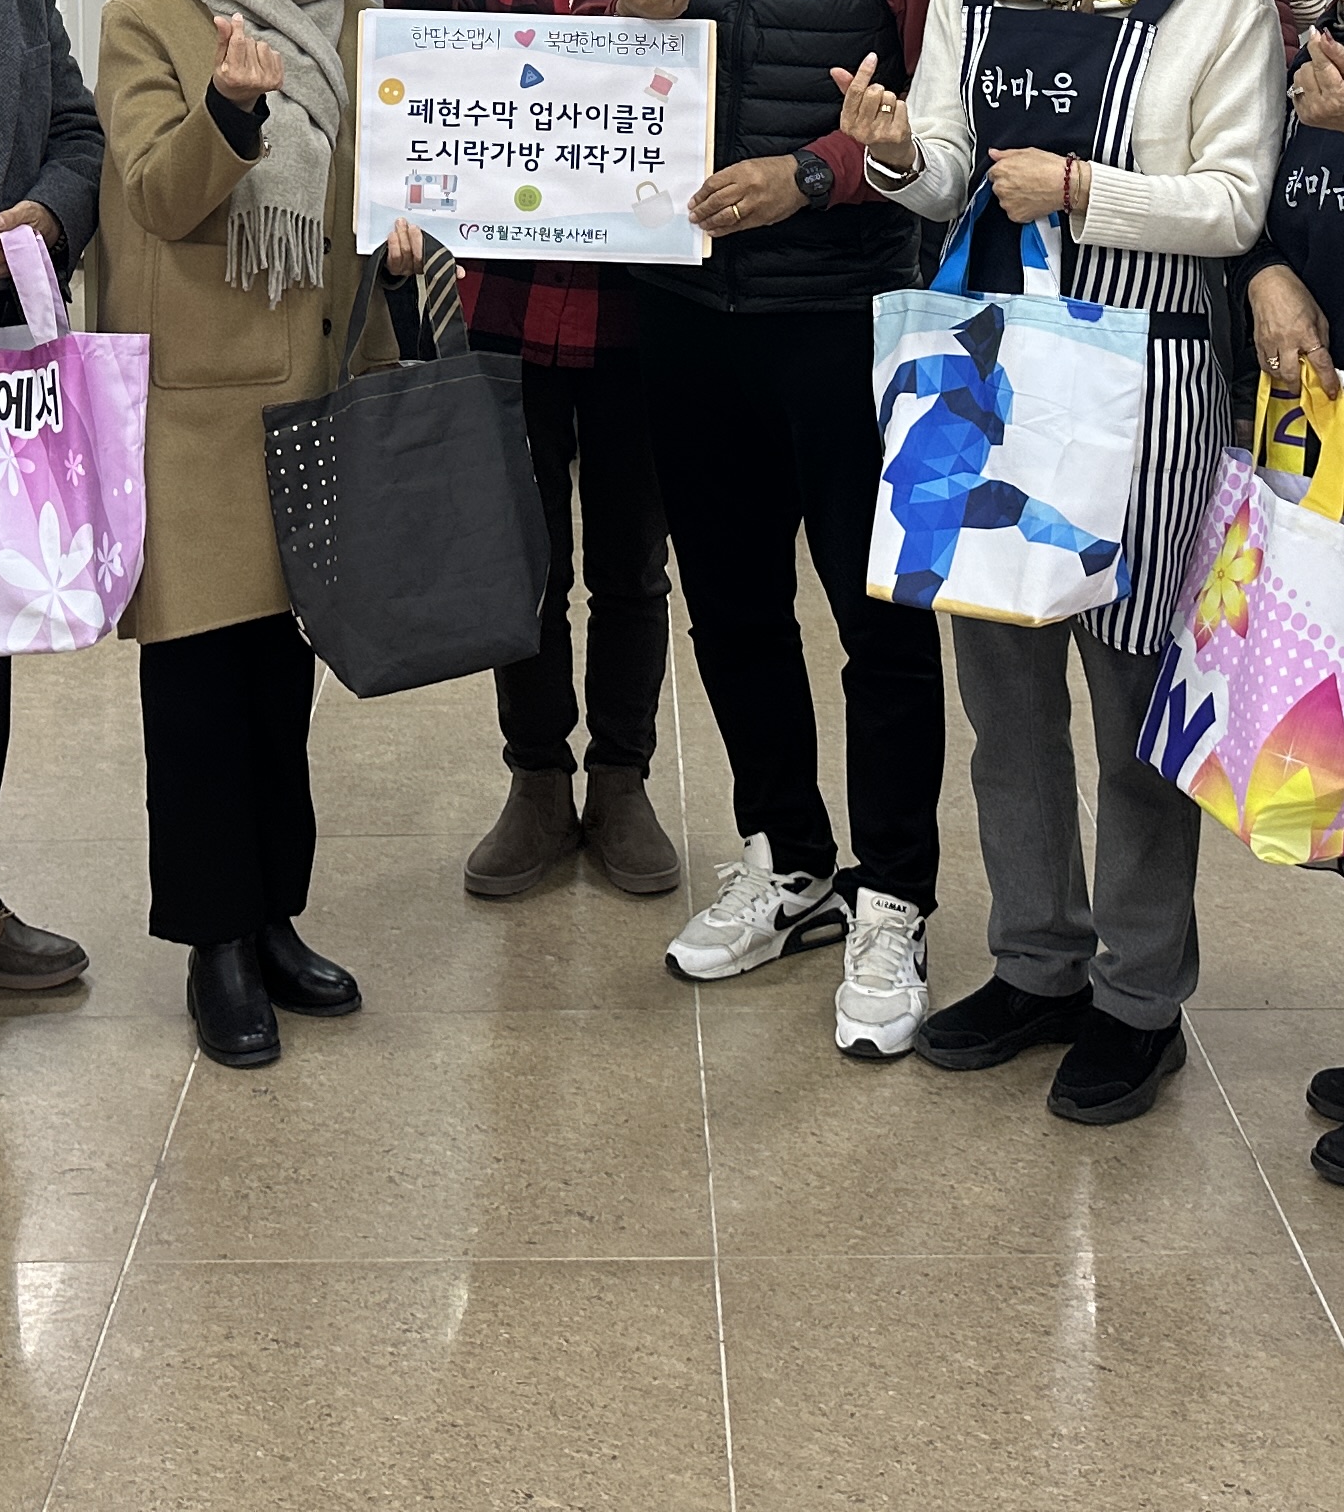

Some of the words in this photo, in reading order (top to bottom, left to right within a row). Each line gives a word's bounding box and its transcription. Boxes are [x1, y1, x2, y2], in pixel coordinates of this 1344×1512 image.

[411, 26, 501, 50] 한땀손맵시
[544, 30, 685, 56] 북면한마음봉사회
[980, 66, 1078, 114] 한마음
[407, 98, 518, 130] 폐현수막
[529, 101, 666, 136] 업사이클링
[405, 139, 544, 172] 도시락가방
[554, 143, 666, 174] 제작기부
[482, 224, 608, 244] 영월군자원봉사센터
